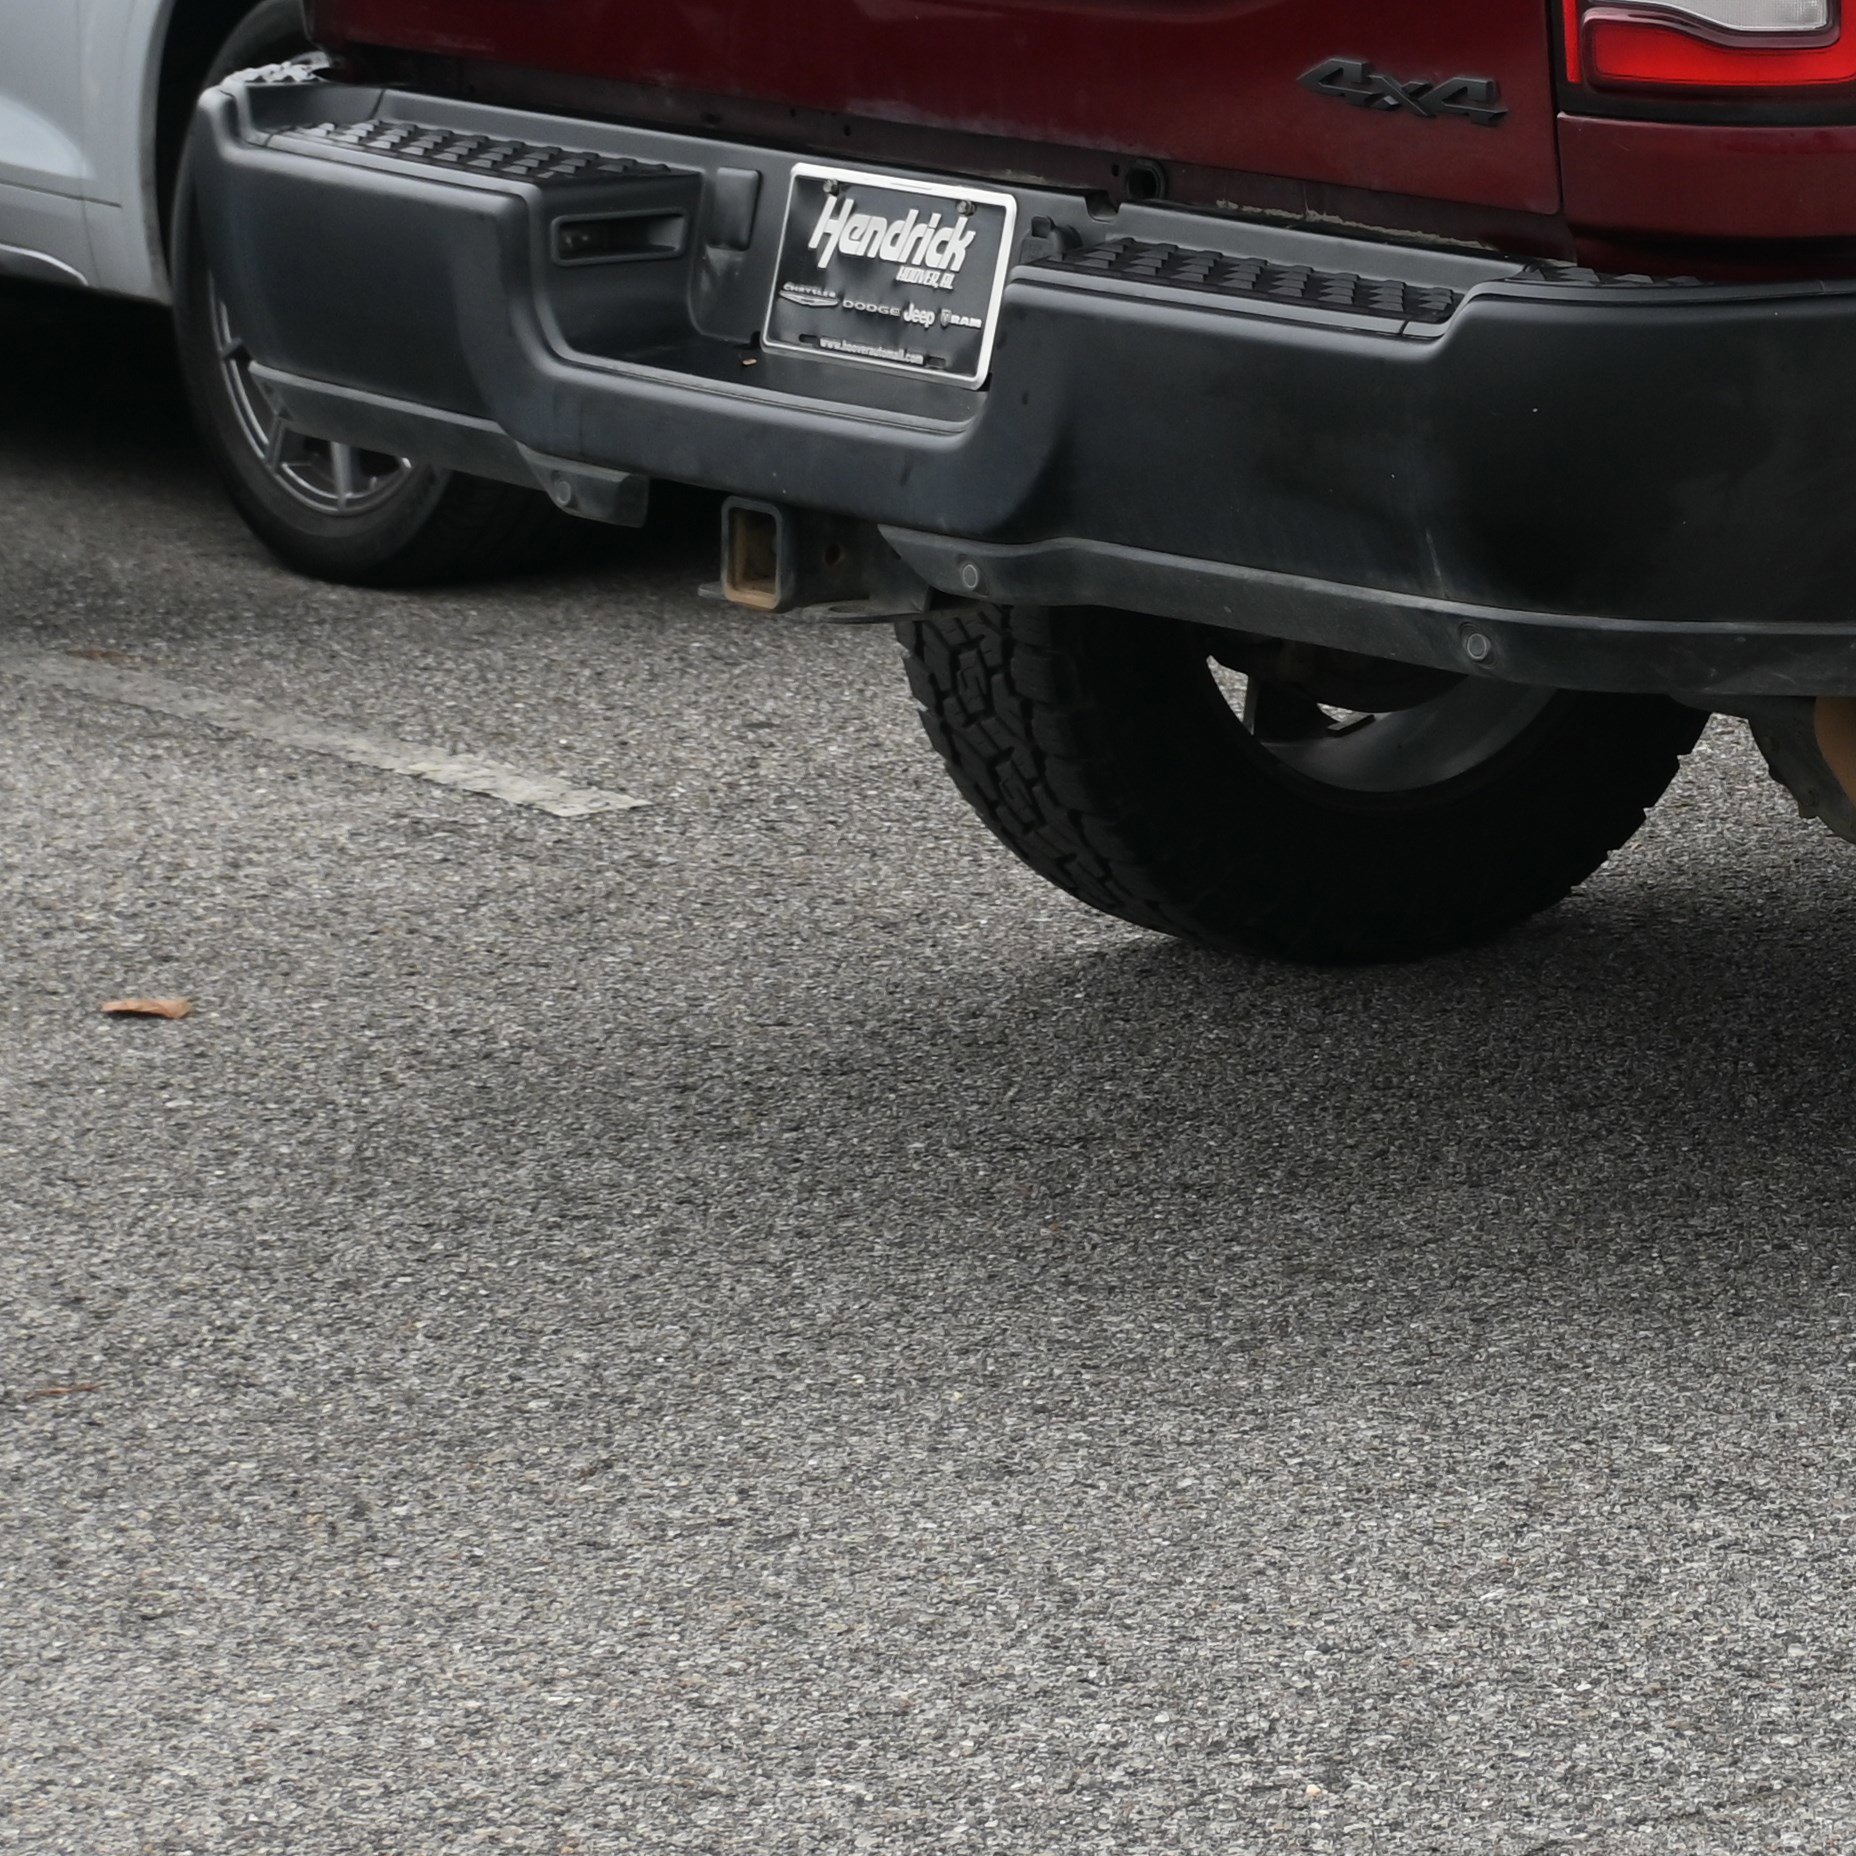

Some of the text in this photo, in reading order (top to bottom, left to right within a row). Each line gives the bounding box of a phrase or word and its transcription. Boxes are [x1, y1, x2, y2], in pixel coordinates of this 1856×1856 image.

[808, 195, 976, 273] Hendrick
[783, 281, 836, 298] CHRYSLER
[842, 298, 901, 317] DODGE
[903, 301, 936, 328] Jeep
[949, 314, 983, 329] RAM
